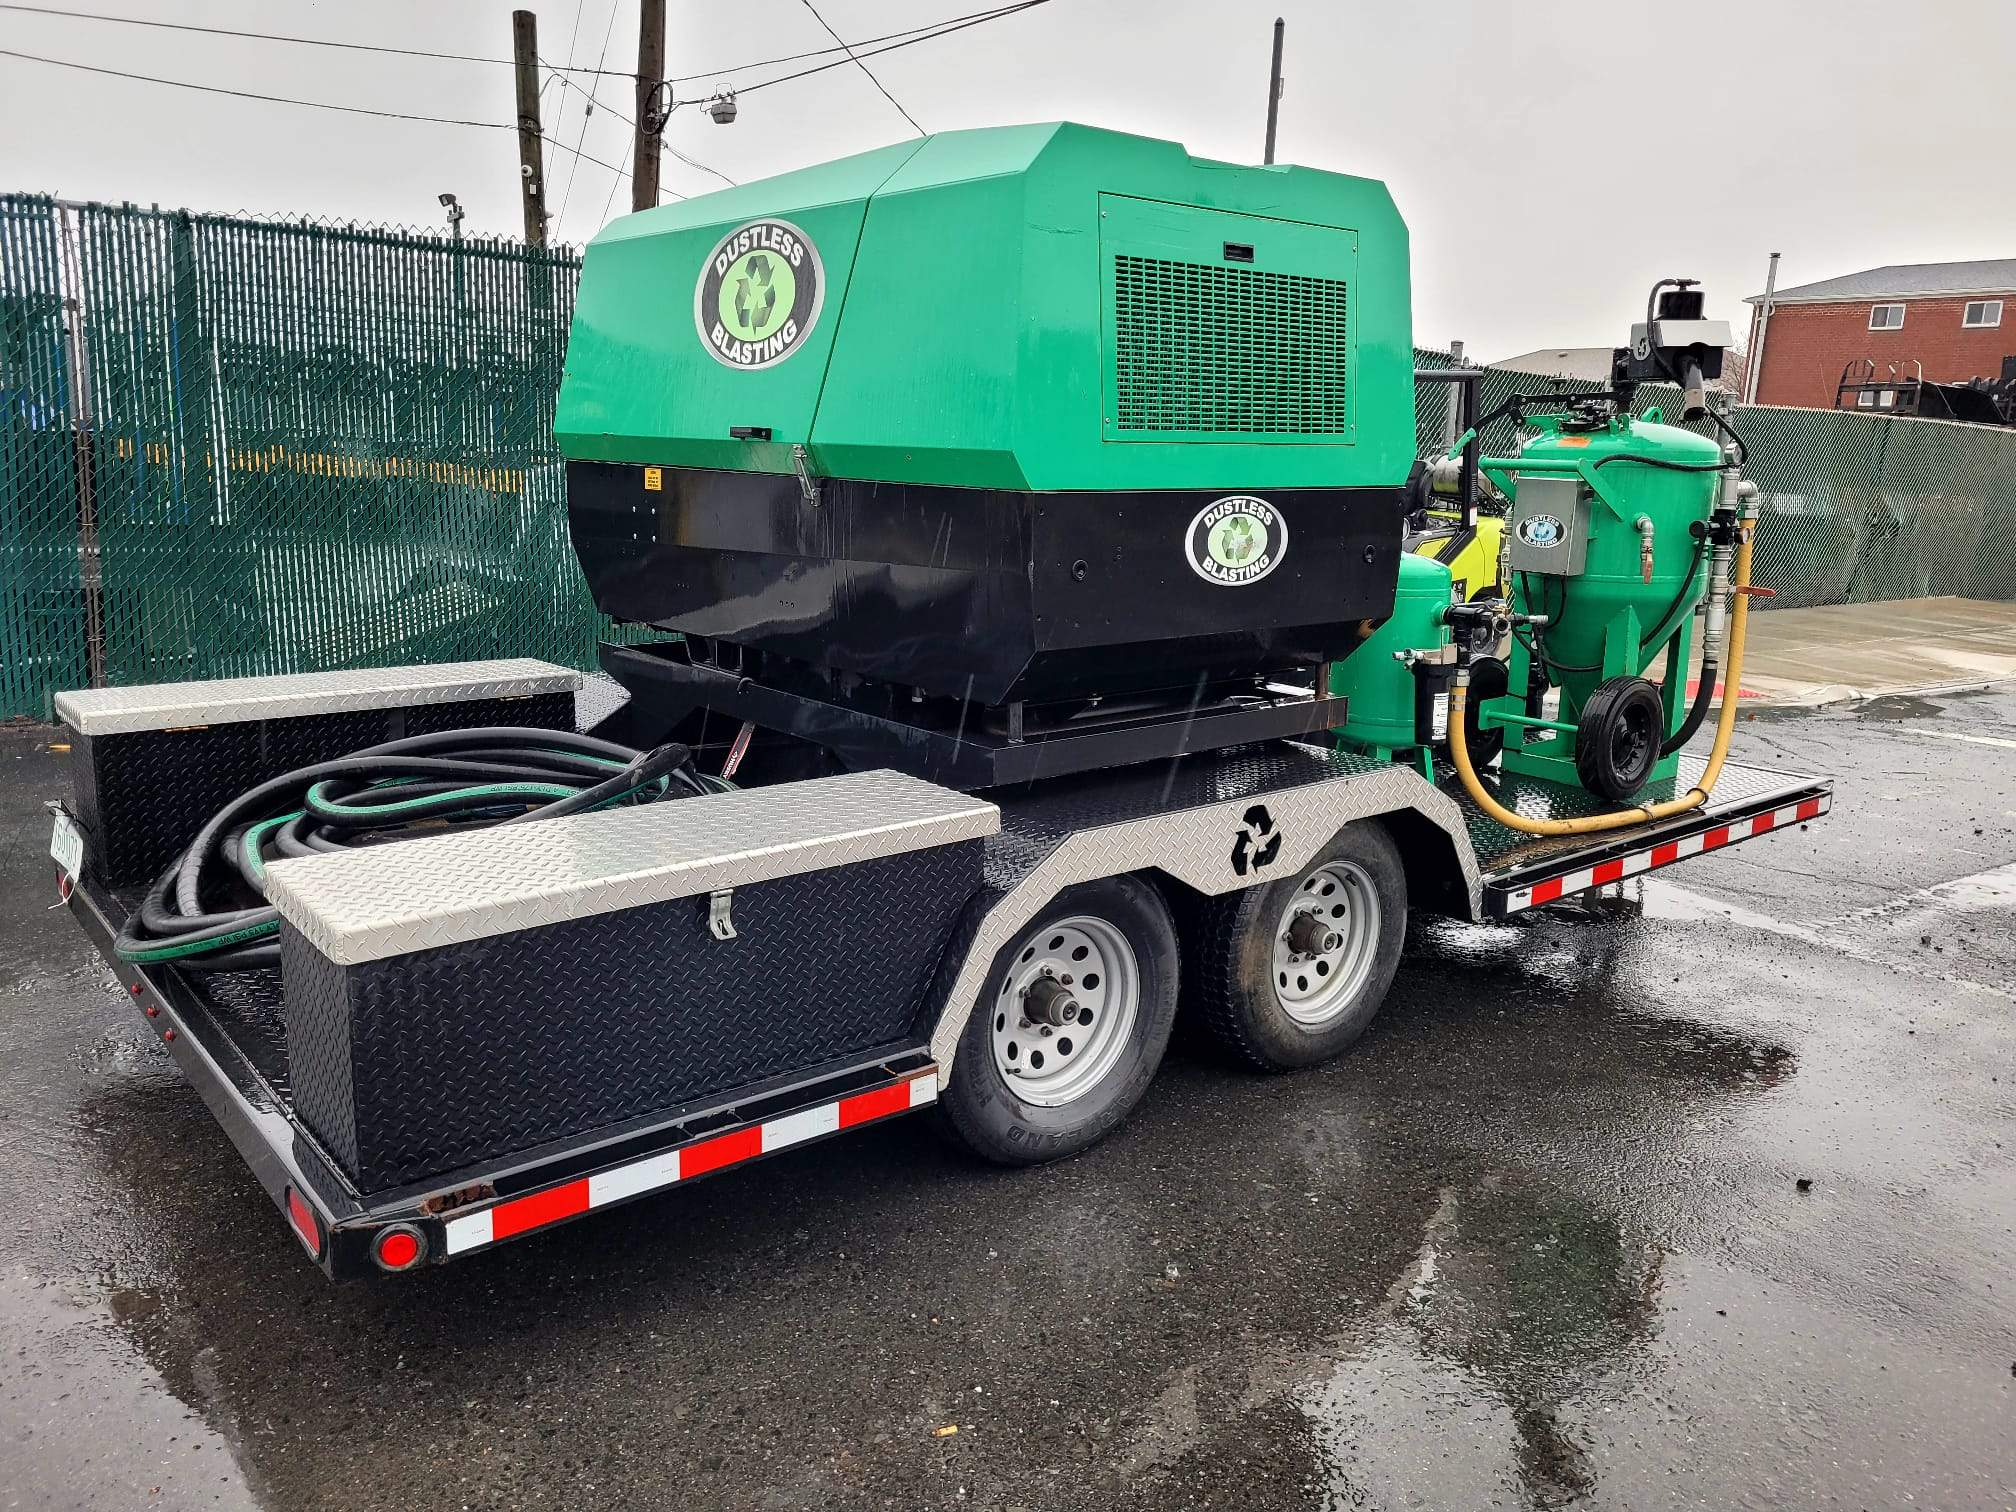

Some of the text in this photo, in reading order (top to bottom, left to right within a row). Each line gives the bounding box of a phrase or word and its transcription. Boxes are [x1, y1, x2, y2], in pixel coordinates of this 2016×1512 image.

[715, 225, 804, 278] DUSTLESS
[711, 318, 798, 364] BLASTING
[1203, 499, 1273, 528] DUSTLESS
[1524, 515, 1559, 527] DUSTLESS
[1523, 535, 1558, 547] BLASTING
[1201, 554, 1270, 581] BLASTING
